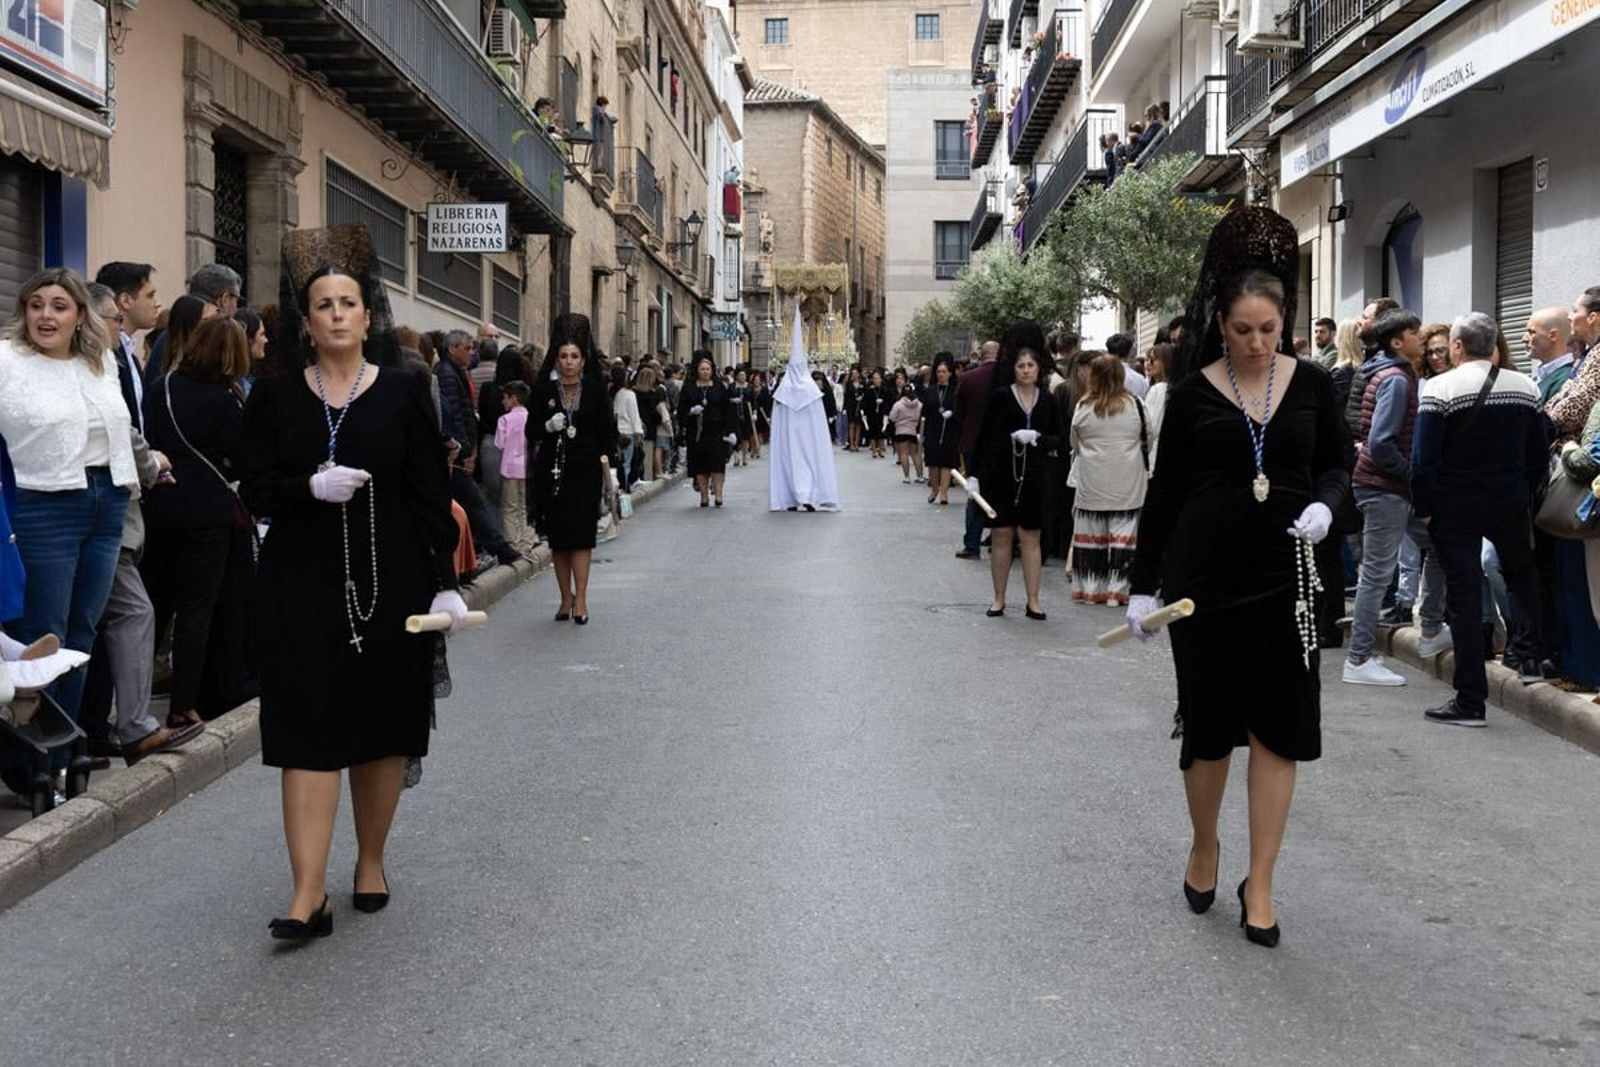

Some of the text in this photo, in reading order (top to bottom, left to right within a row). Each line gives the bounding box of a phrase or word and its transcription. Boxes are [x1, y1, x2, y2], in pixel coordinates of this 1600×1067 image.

[436, 207, 498, 219] LIBRERIA
[432, 222, 502, 234] RELIGIOSA
[431, 236, 502, 249] NAZARENAS
